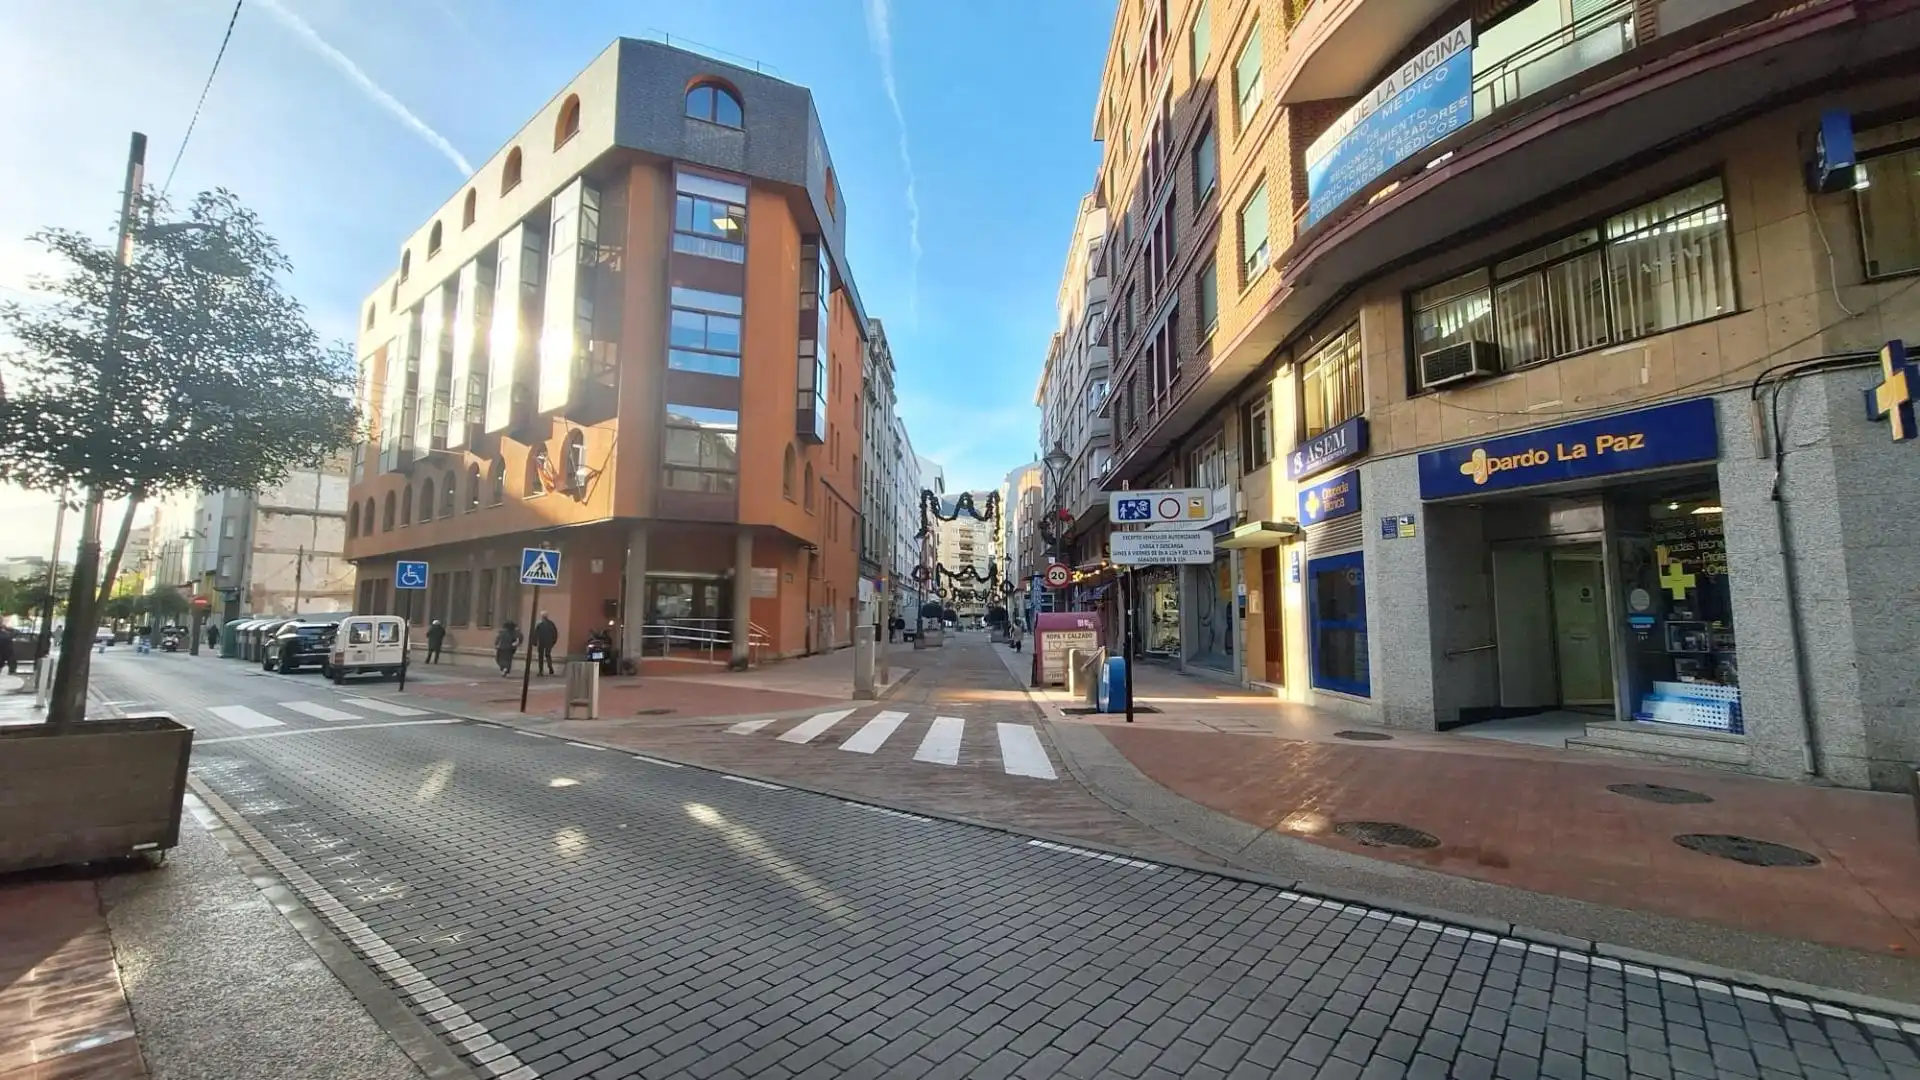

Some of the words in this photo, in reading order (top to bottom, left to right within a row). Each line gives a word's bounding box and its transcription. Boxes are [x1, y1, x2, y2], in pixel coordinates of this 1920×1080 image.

[1352, 103, 1369, 124] DE
[1376, 78, 1396, 105] LA
[1402, 29, 1467, 85] ENCINA
[1381, 67, 1449, 120] MEDICO
[1388, 95, 1469, 151] CAZADORES
[1393, 115, 1458, 162] MEDICOS
[1306, 428, 1347, 464] ASEM
[1557, 442, 1586, 462] La
[1596, 432, 1645, 455] Paz
[1051, 571, 1065, 580] 20
